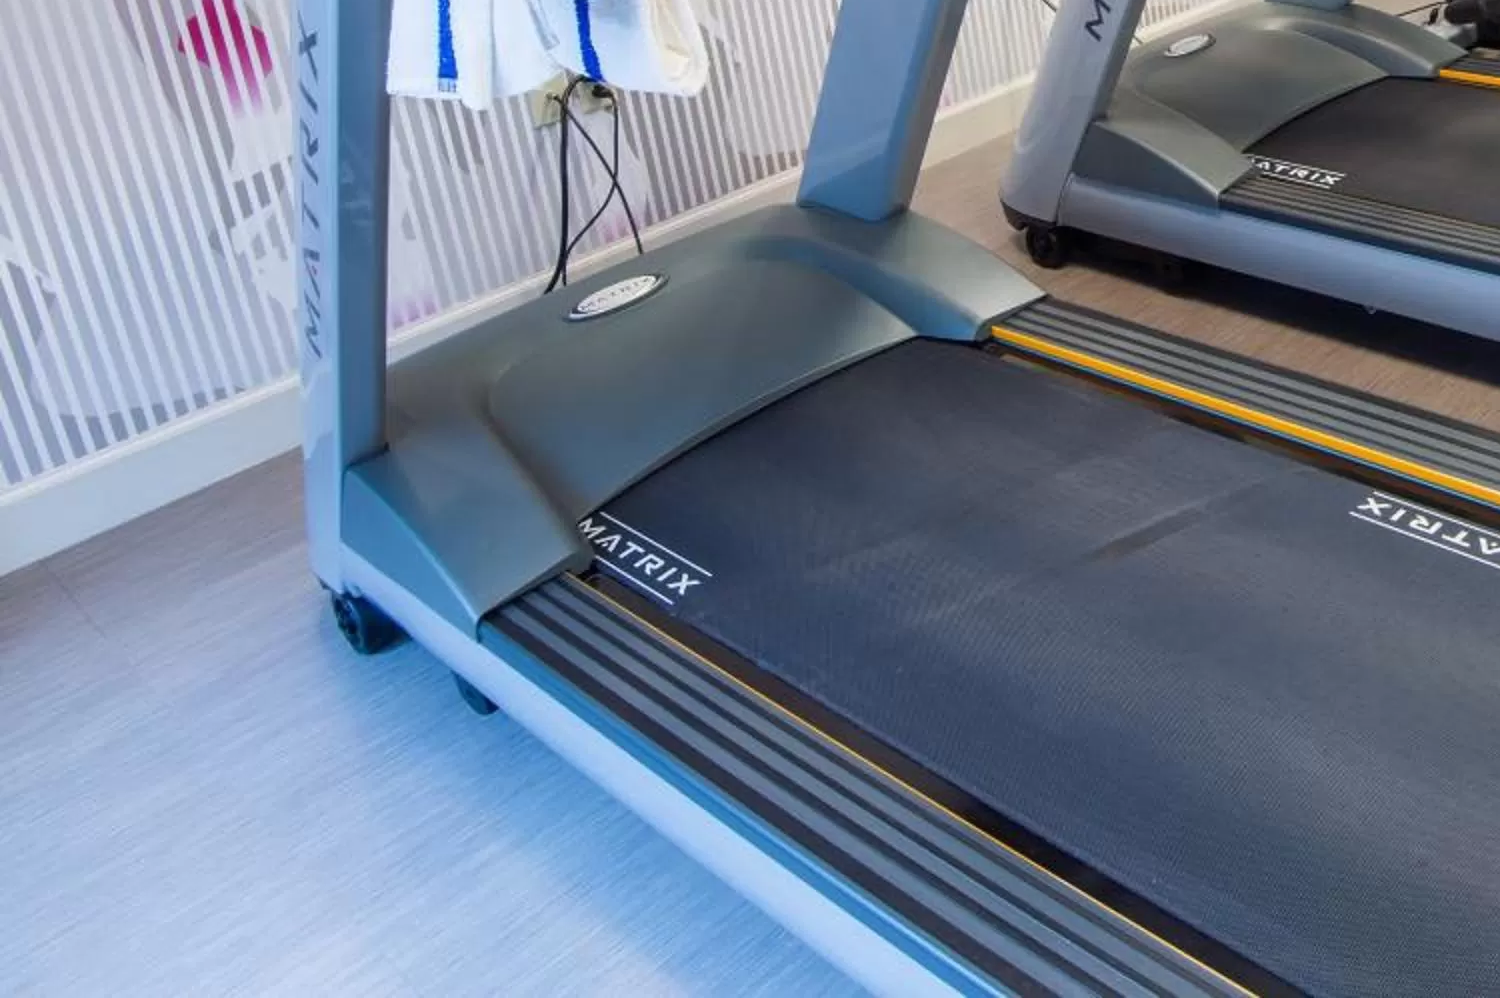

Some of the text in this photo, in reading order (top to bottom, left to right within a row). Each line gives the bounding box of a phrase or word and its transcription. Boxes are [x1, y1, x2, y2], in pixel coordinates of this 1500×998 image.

[298, 10, 322, 359] MATRIX
[1251, 157, 1342, 185] ATRIX
[578, 517, 703, 596] MATRIX
